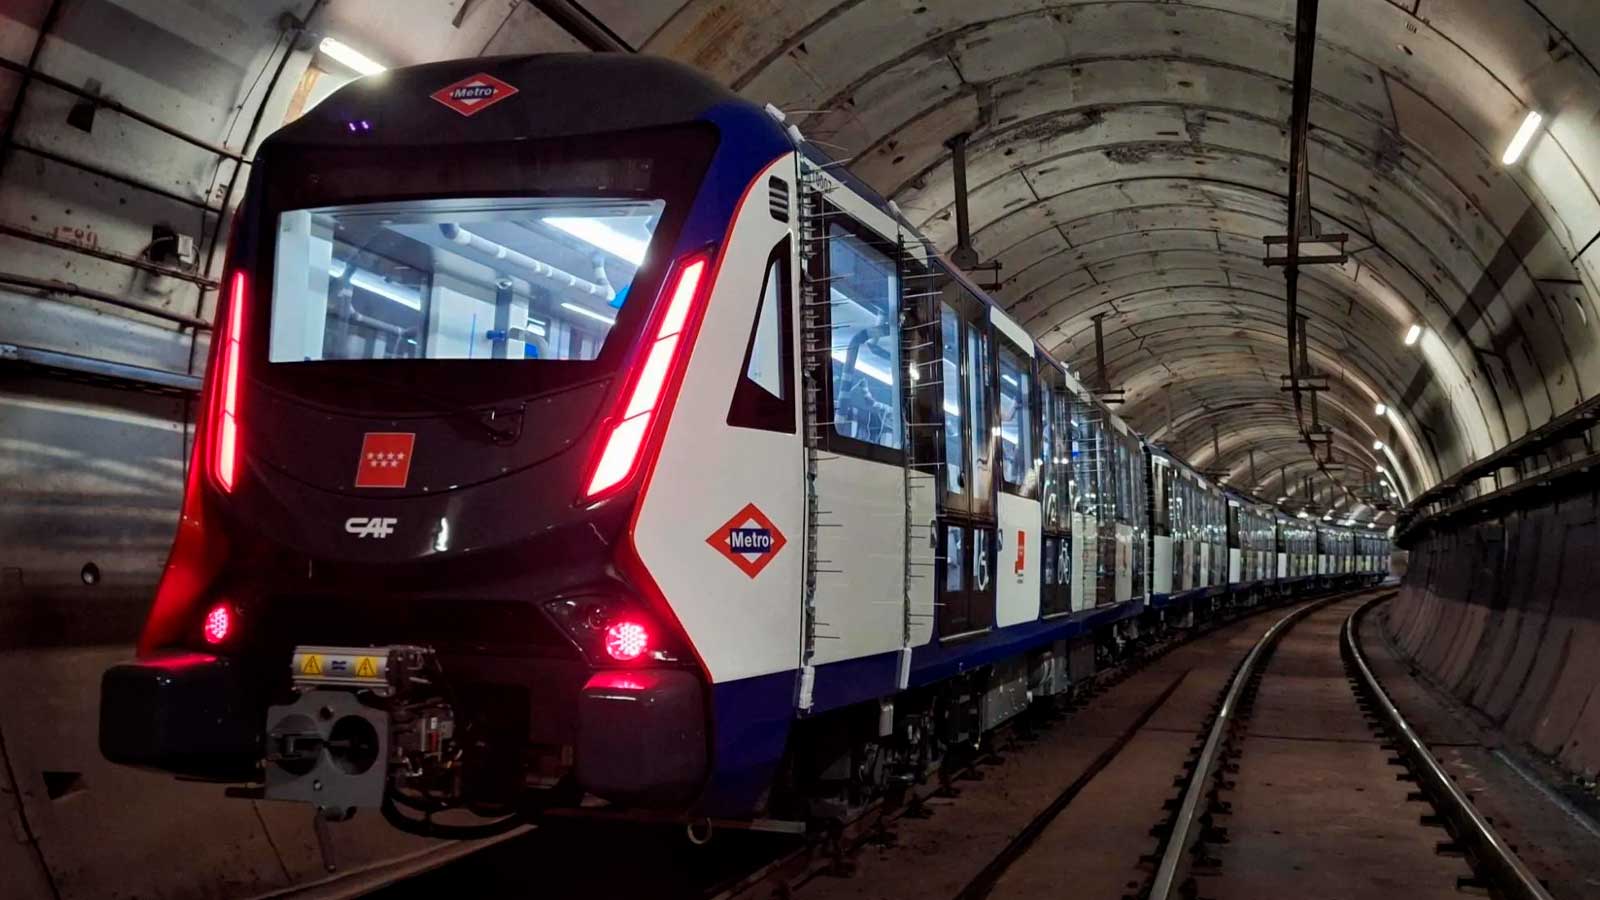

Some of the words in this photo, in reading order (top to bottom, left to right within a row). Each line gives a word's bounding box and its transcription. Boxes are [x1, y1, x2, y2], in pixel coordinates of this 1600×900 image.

[454, 87, 492, 98] Metro
[345, 517, 398, 538] CAF
[731, 531, 770, 547] Metro
